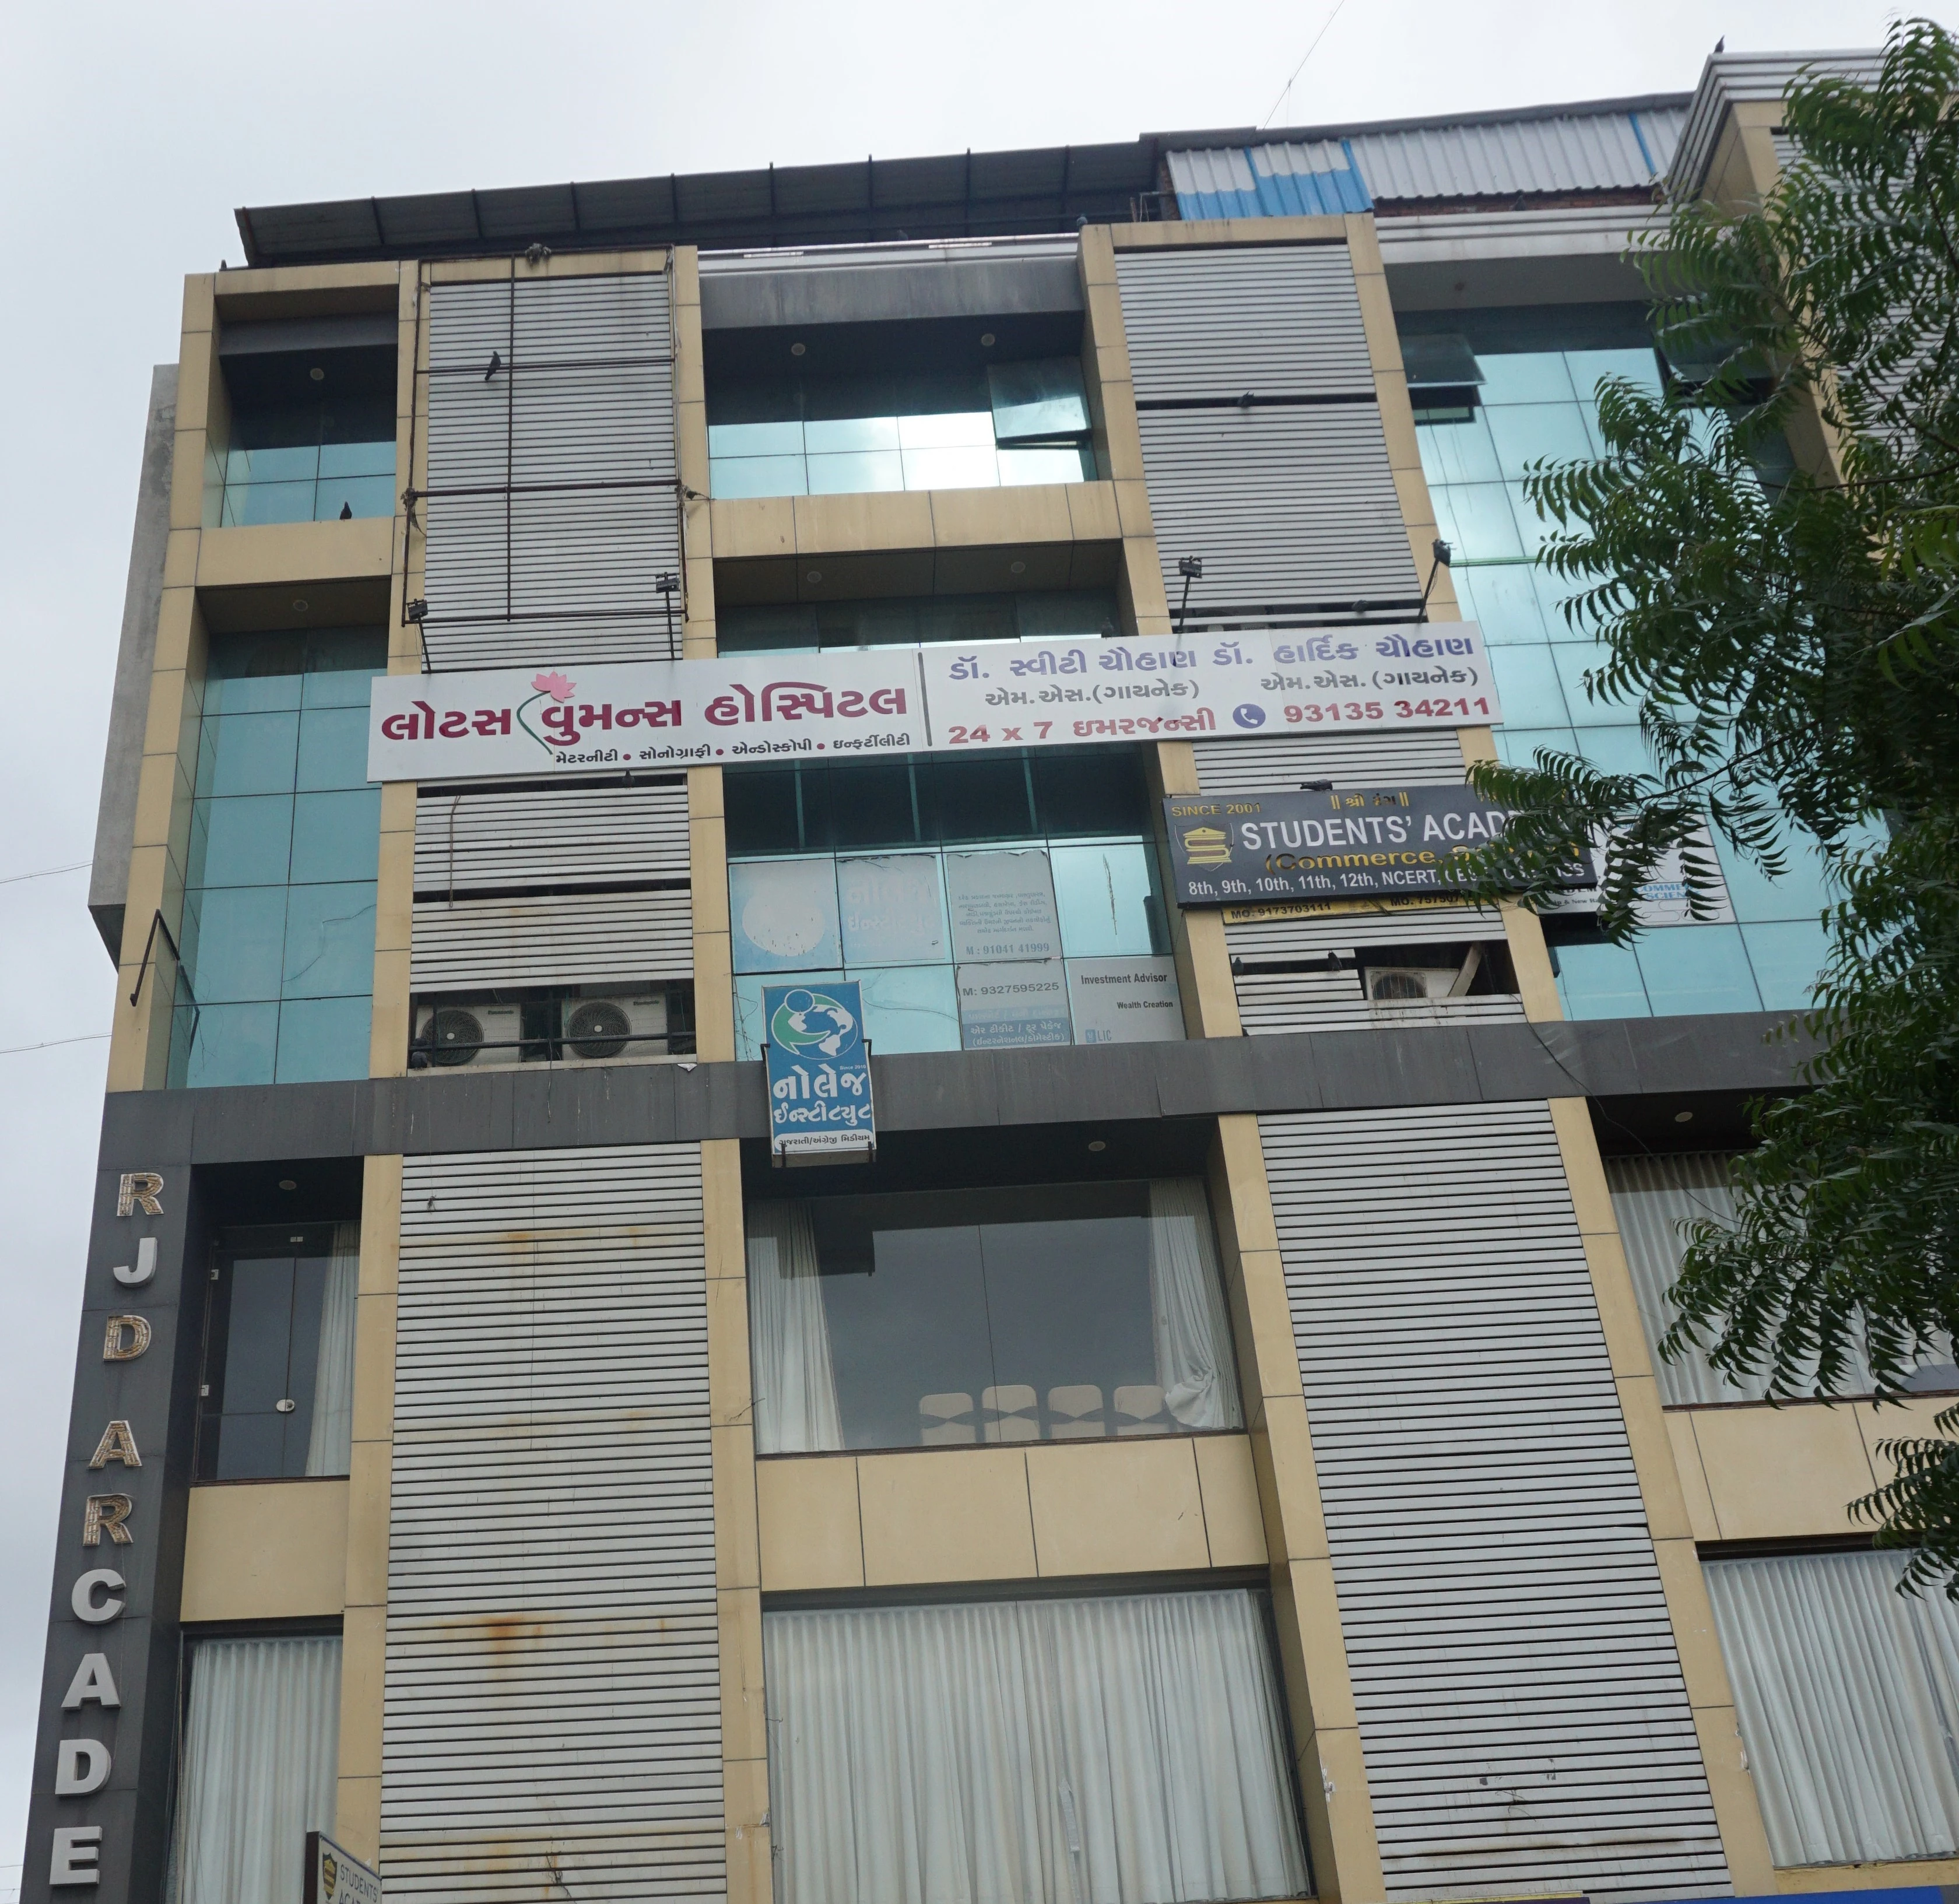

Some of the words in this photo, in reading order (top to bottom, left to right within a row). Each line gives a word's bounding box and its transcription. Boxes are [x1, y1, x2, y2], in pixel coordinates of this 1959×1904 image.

[1010, 649, 1087, 677] સ્વીટી
[1273, 634, 1359, 664] હાર્દિક
[381, 700, 511, 740] લોટસ
[541, 700, 682, 746] વુમન્સ
[704, 681, 907, 726] હોસ્પિટલ
[948, 724, 990, 744] 24
[1034, 721, 1053, 739] 7
[1284, 701, 1384, 723] 93135
[1394, 697, 1490, 718] 34211
[556, 748, 618, 764] મેટરનીટી
[639, 743, 711, 760] સોનોગ્રાફી
[732, 737, 812, 755] એન્ડોસ્કોપી
[1172, 805, 1221, 817] SINCE
[1226, 802, 1262, 814] 2001
[1242, 816, 1412, 850] STUDENTS'
[1189, 881, 1219, 896] 8th,
[1222, 879, 1252, 895] 9th,
[1256, 877, 1294, 893] 10th,
[1298, 874, 1336, 891] 11th,
[1340, 872, 1378, 888] 12th,
[1382, 869, 1441, 886] NCERT,
[1258, 903, 1332, 916] 9173703111
[1391, 897, 1414, 907] MO.
[983, 944, 1014, 955] 91041
[1017, 943, 1050, 954] 41999
[1081, 974, 1132, 985] Investment
[1134, 973, 1168, 983] Advisor
[981, 982, 1059, 995] 9327595225
[1117, 1001, 1142, 1009] Wealth
[1143, 1000, 1174, 1009] Creation
[1097, 1030, 1112, 1041] LIC
[773, 1063, 867, 1100] નોલેજ
[841, 1134, 870, 1143] મિડીયમ
[49, 1420, 142, 1885] ARCADE
